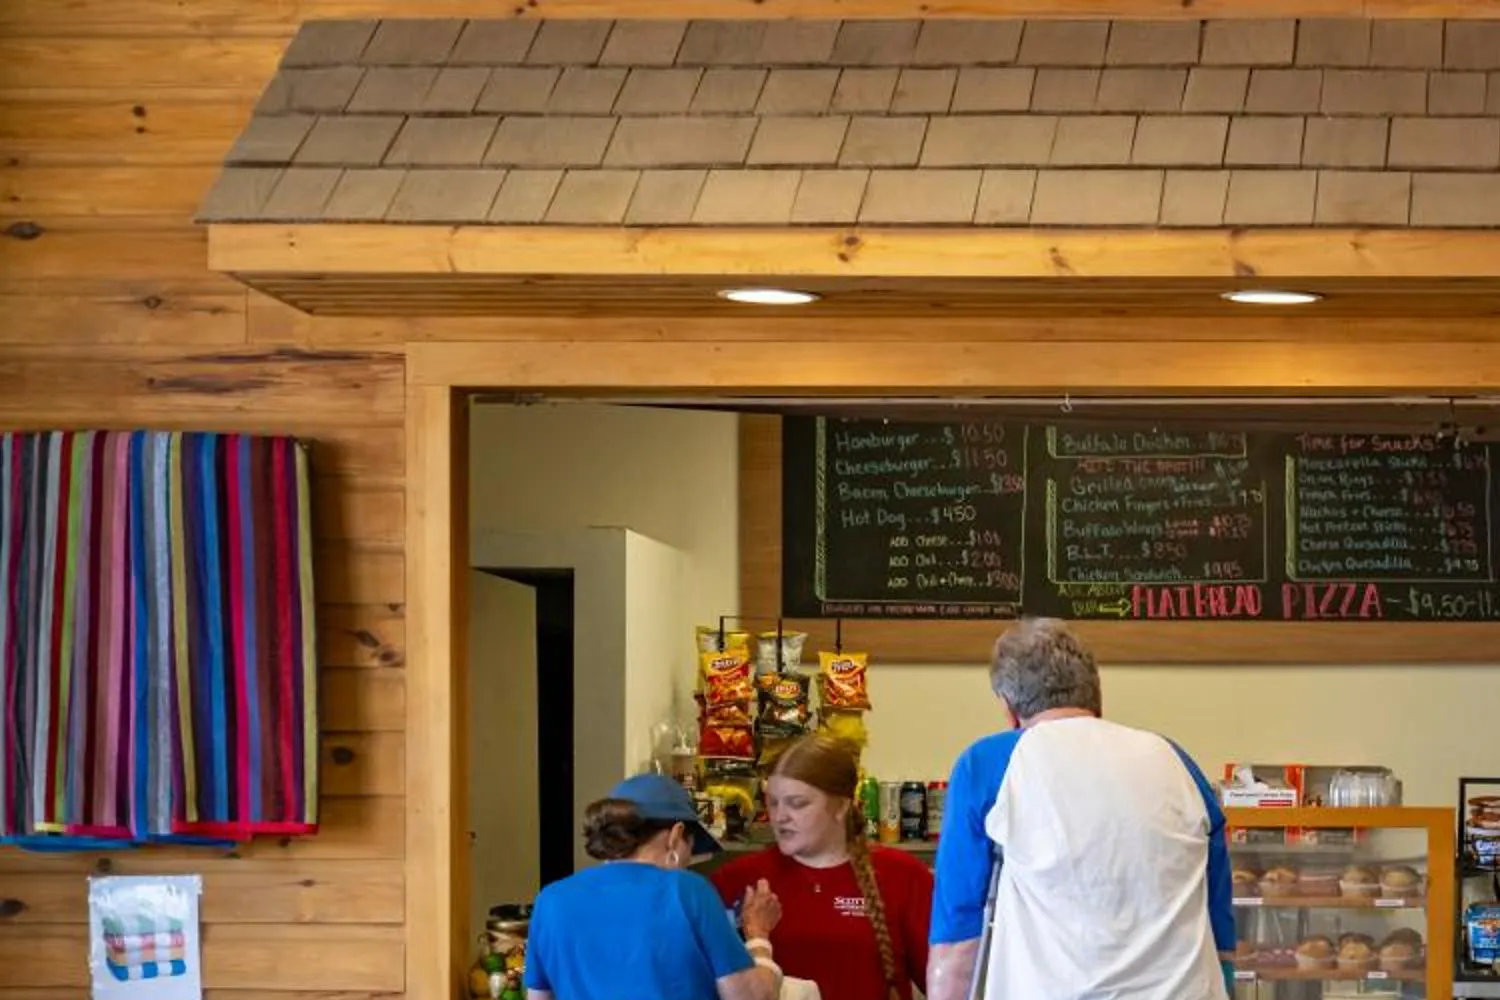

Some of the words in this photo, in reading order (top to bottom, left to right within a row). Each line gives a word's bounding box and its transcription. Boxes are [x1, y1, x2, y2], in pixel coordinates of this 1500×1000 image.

[836, 432, 919, 452] Hamburger
[1341, 434, 1366, 455] for
[835, 455, 930, 478] Cheeseburger
[841, 508, 869, 528] Hot
[877, 508, 905, 531] Dog
[1281, 582, 1386, 619] PIZZA
